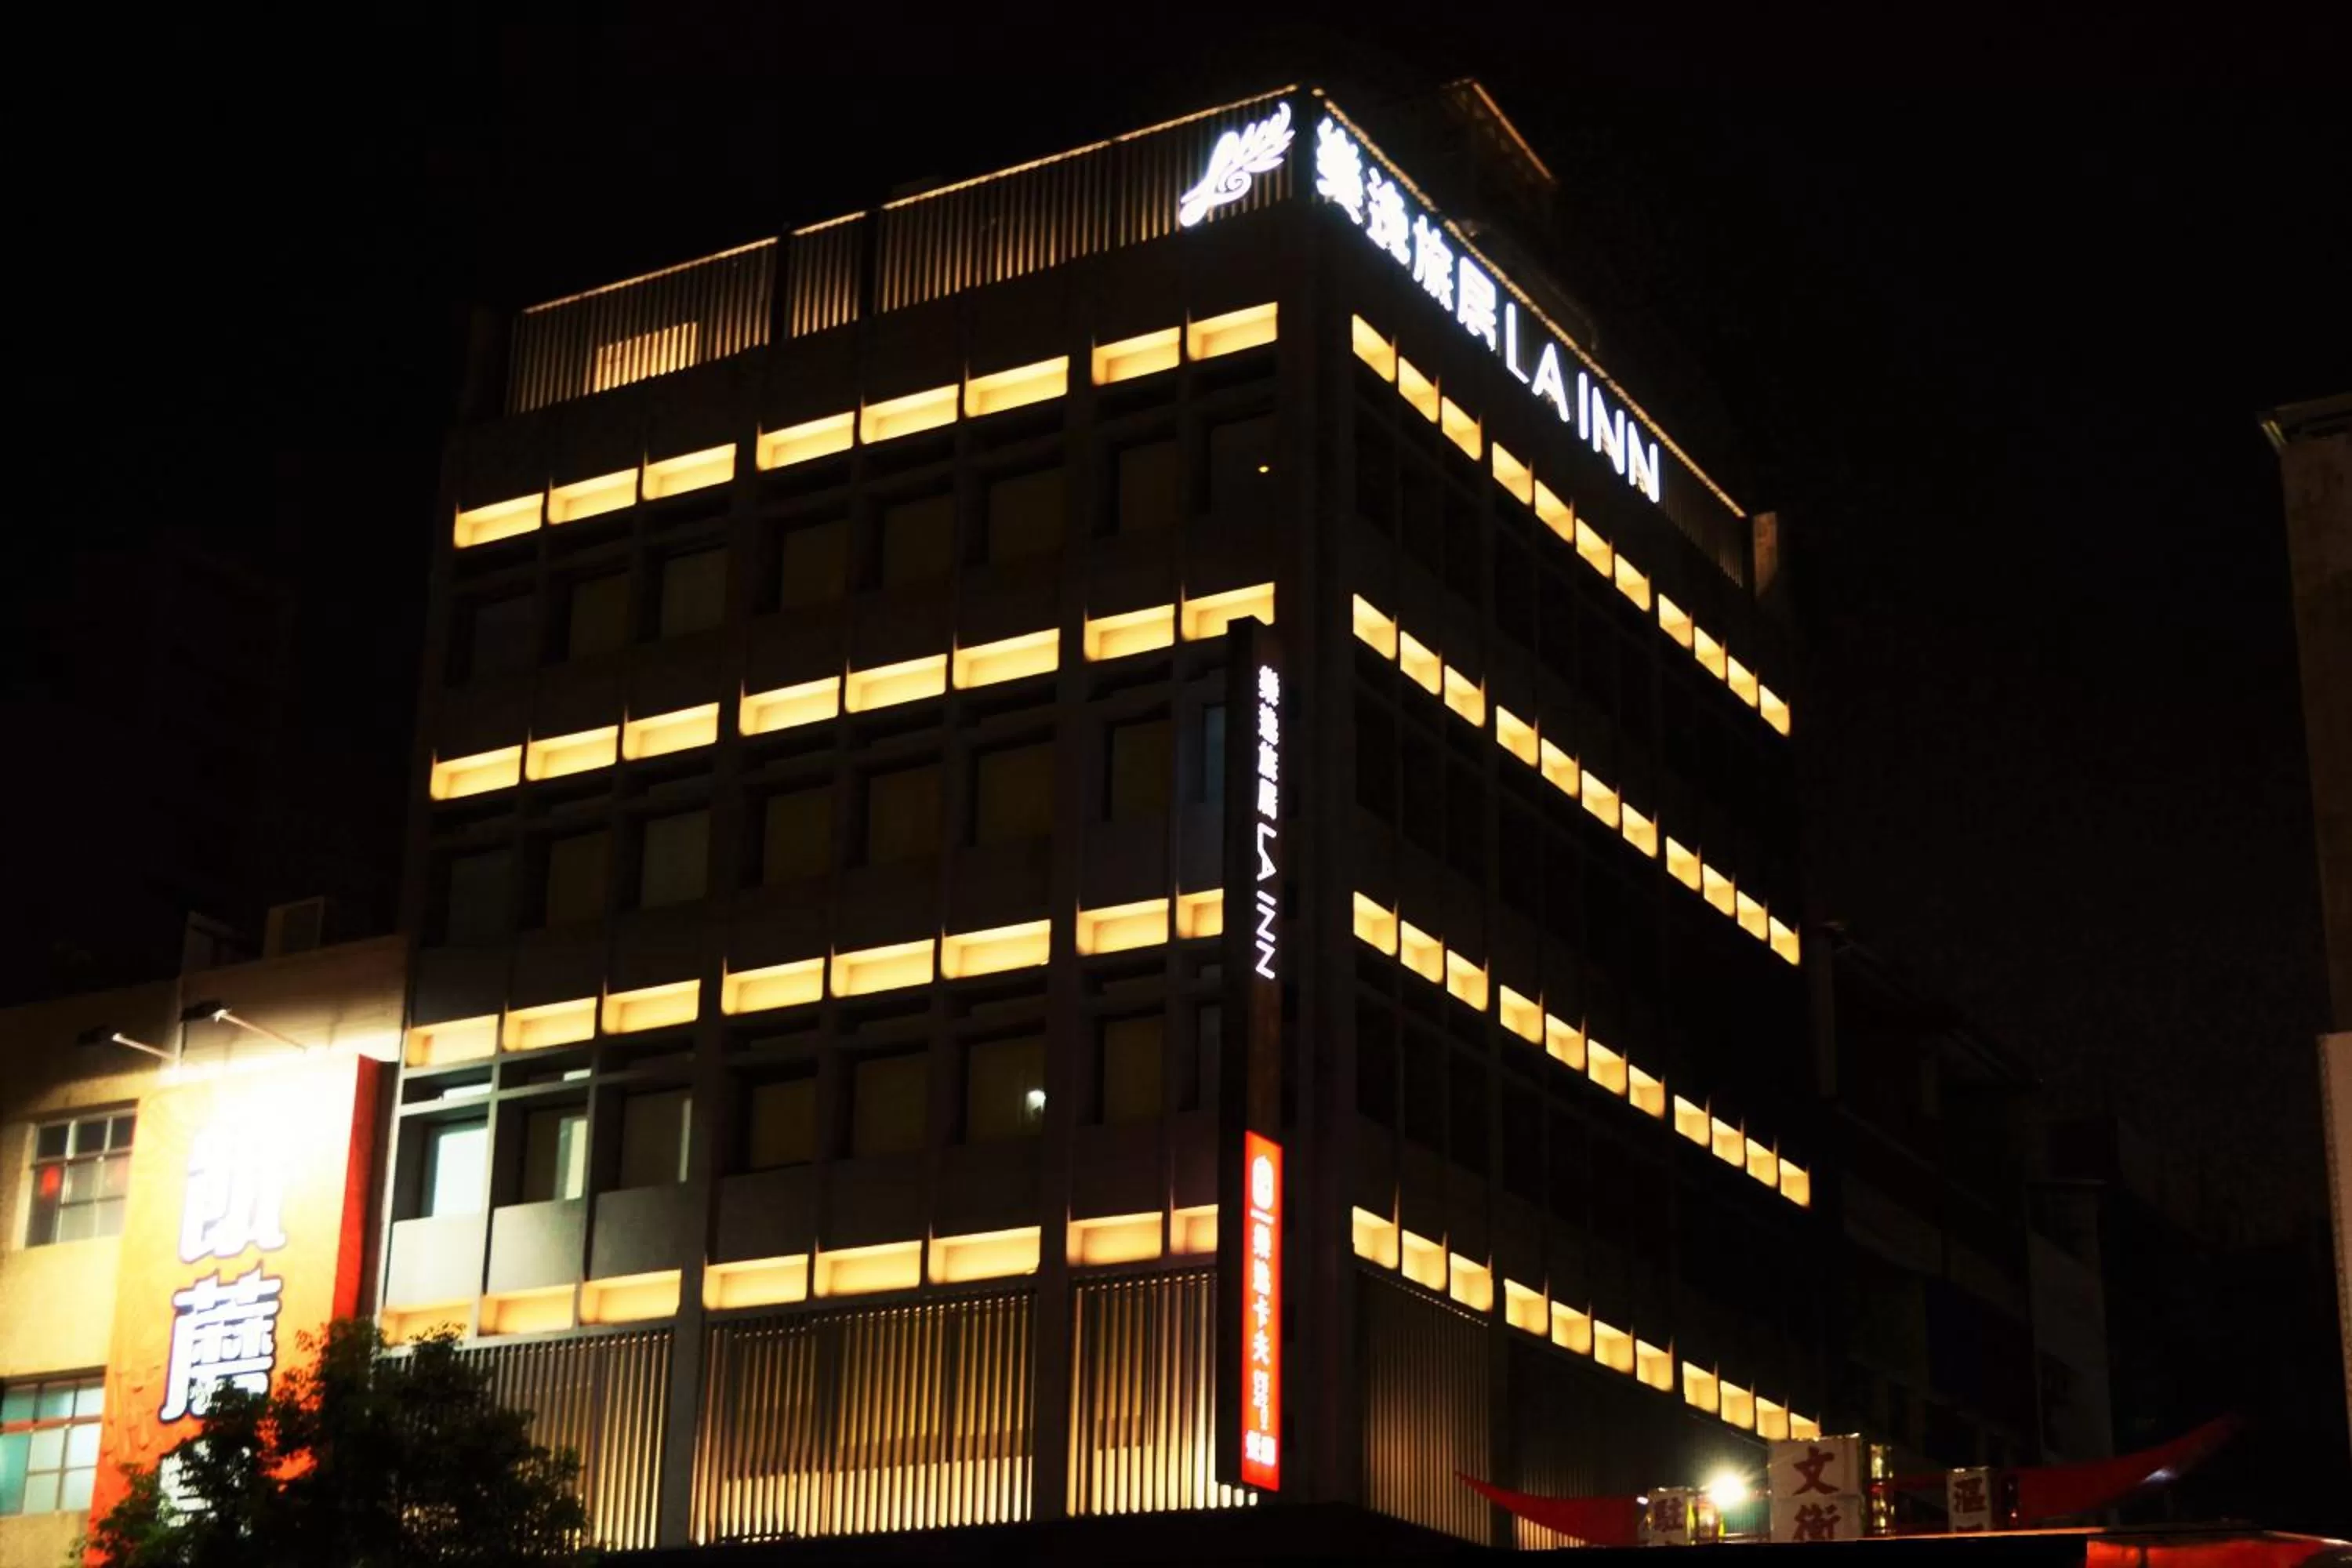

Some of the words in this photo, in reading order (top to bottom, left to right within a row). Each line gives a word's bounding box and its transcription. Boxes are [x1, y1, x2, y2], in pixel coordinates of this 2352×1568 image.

[1504, 303, 1570, 422] LA
[1577, 372, 1661, 503] INN
[1257, 821, 1278, 881] LA
[1255, 890, 1277, 979] INN
[1654, 1497, 1684, 1545] 駐
